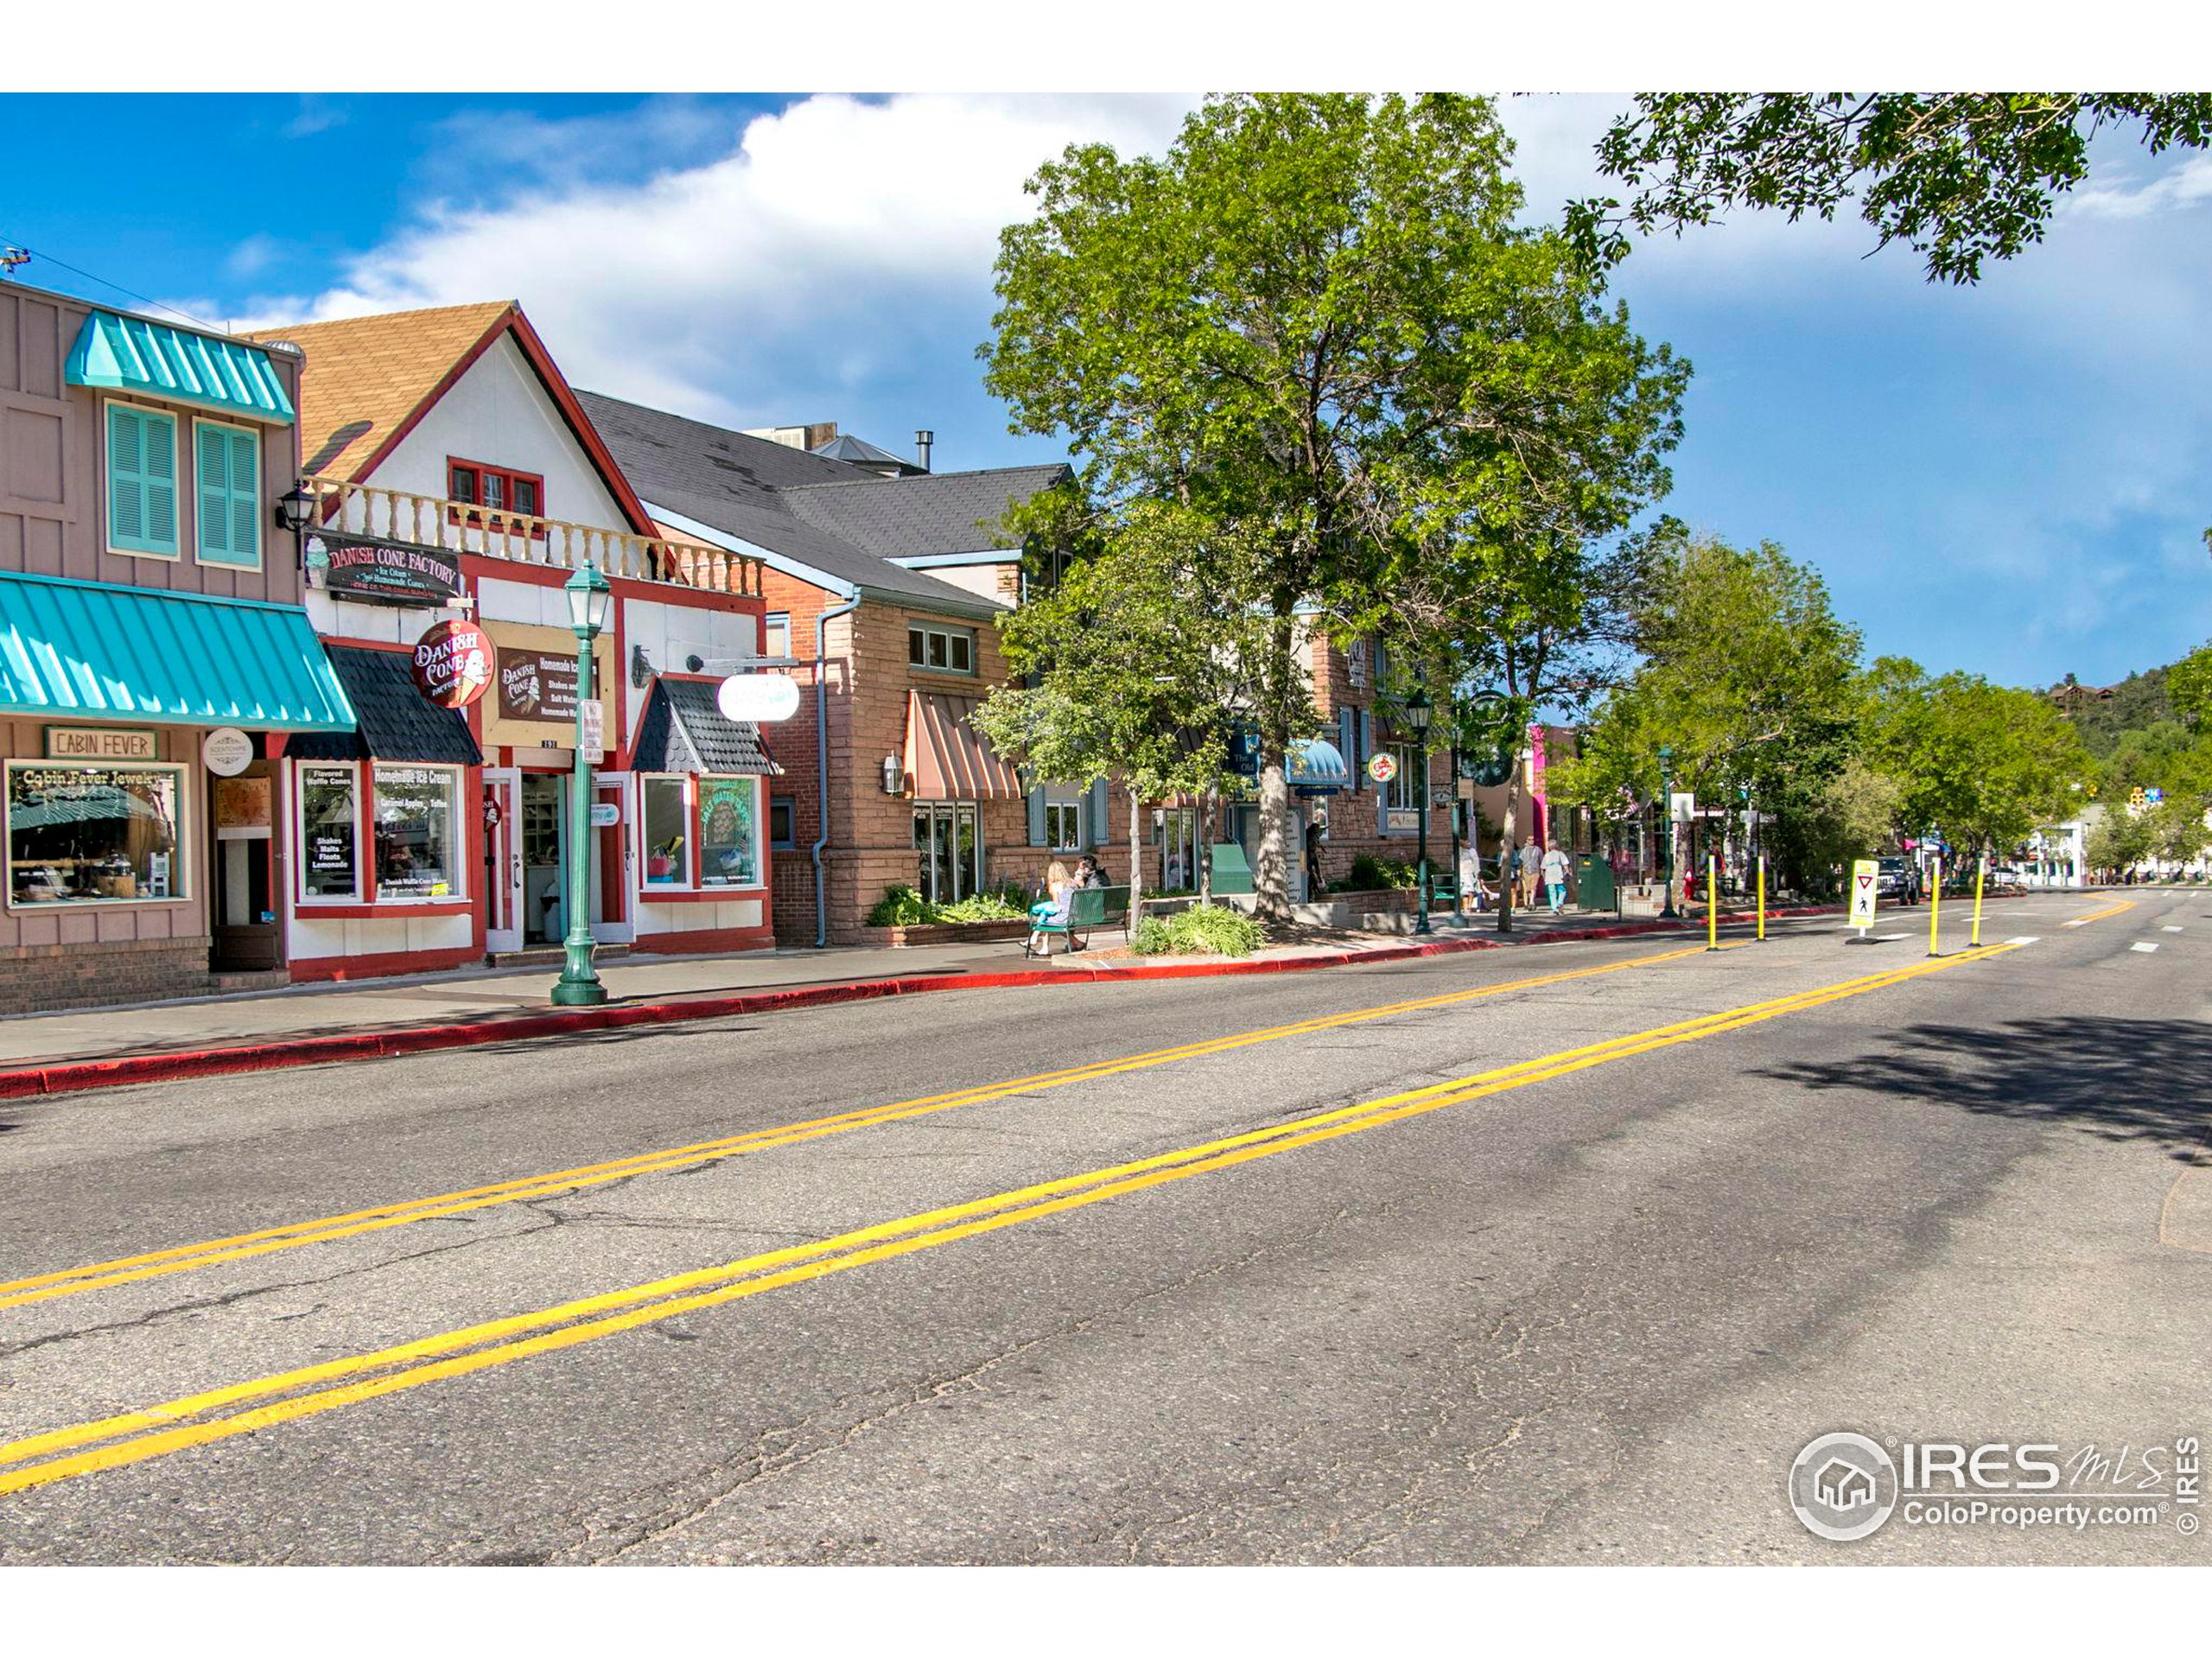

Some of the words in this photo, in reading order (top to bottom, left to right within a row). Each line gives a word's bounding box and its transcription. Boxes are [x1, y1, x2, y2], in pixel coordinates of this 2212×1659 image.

[330, 547, 375, 569] DANISH
[377, 549, 406, 568] CONE
[408, 553, 456, 585] FACTORY
[415, 632, 479, 667] DANISH
[426, 654, 465, 685] CONE
[539, 657, 570, 672] Homemade
[502, 664, 536, 685] DANISH
[508, 679, 530, 699] CONE
[548, 680, 569, 690] Shakes
[550, 694, 563, 702] Salt
[541, 707, 569, 717] Homemade
[56, 734, 99, 753] CABIN
[104, 735, 149, 755] FEVER
[1234, 753, 1249, 762] The
[1241, 762, 1255, 772] Old
[23, 770, 67, 785] Cabin
[69, 771, 109, 785] Fever
[111, 771, 162, 785] Jewelry
[374, 768, 416, 785] Homemade
[416, 769, 428, 784] Ice
[429, 769, 452, 785] Cream
[312, 861, 348, 869] Lemonade
